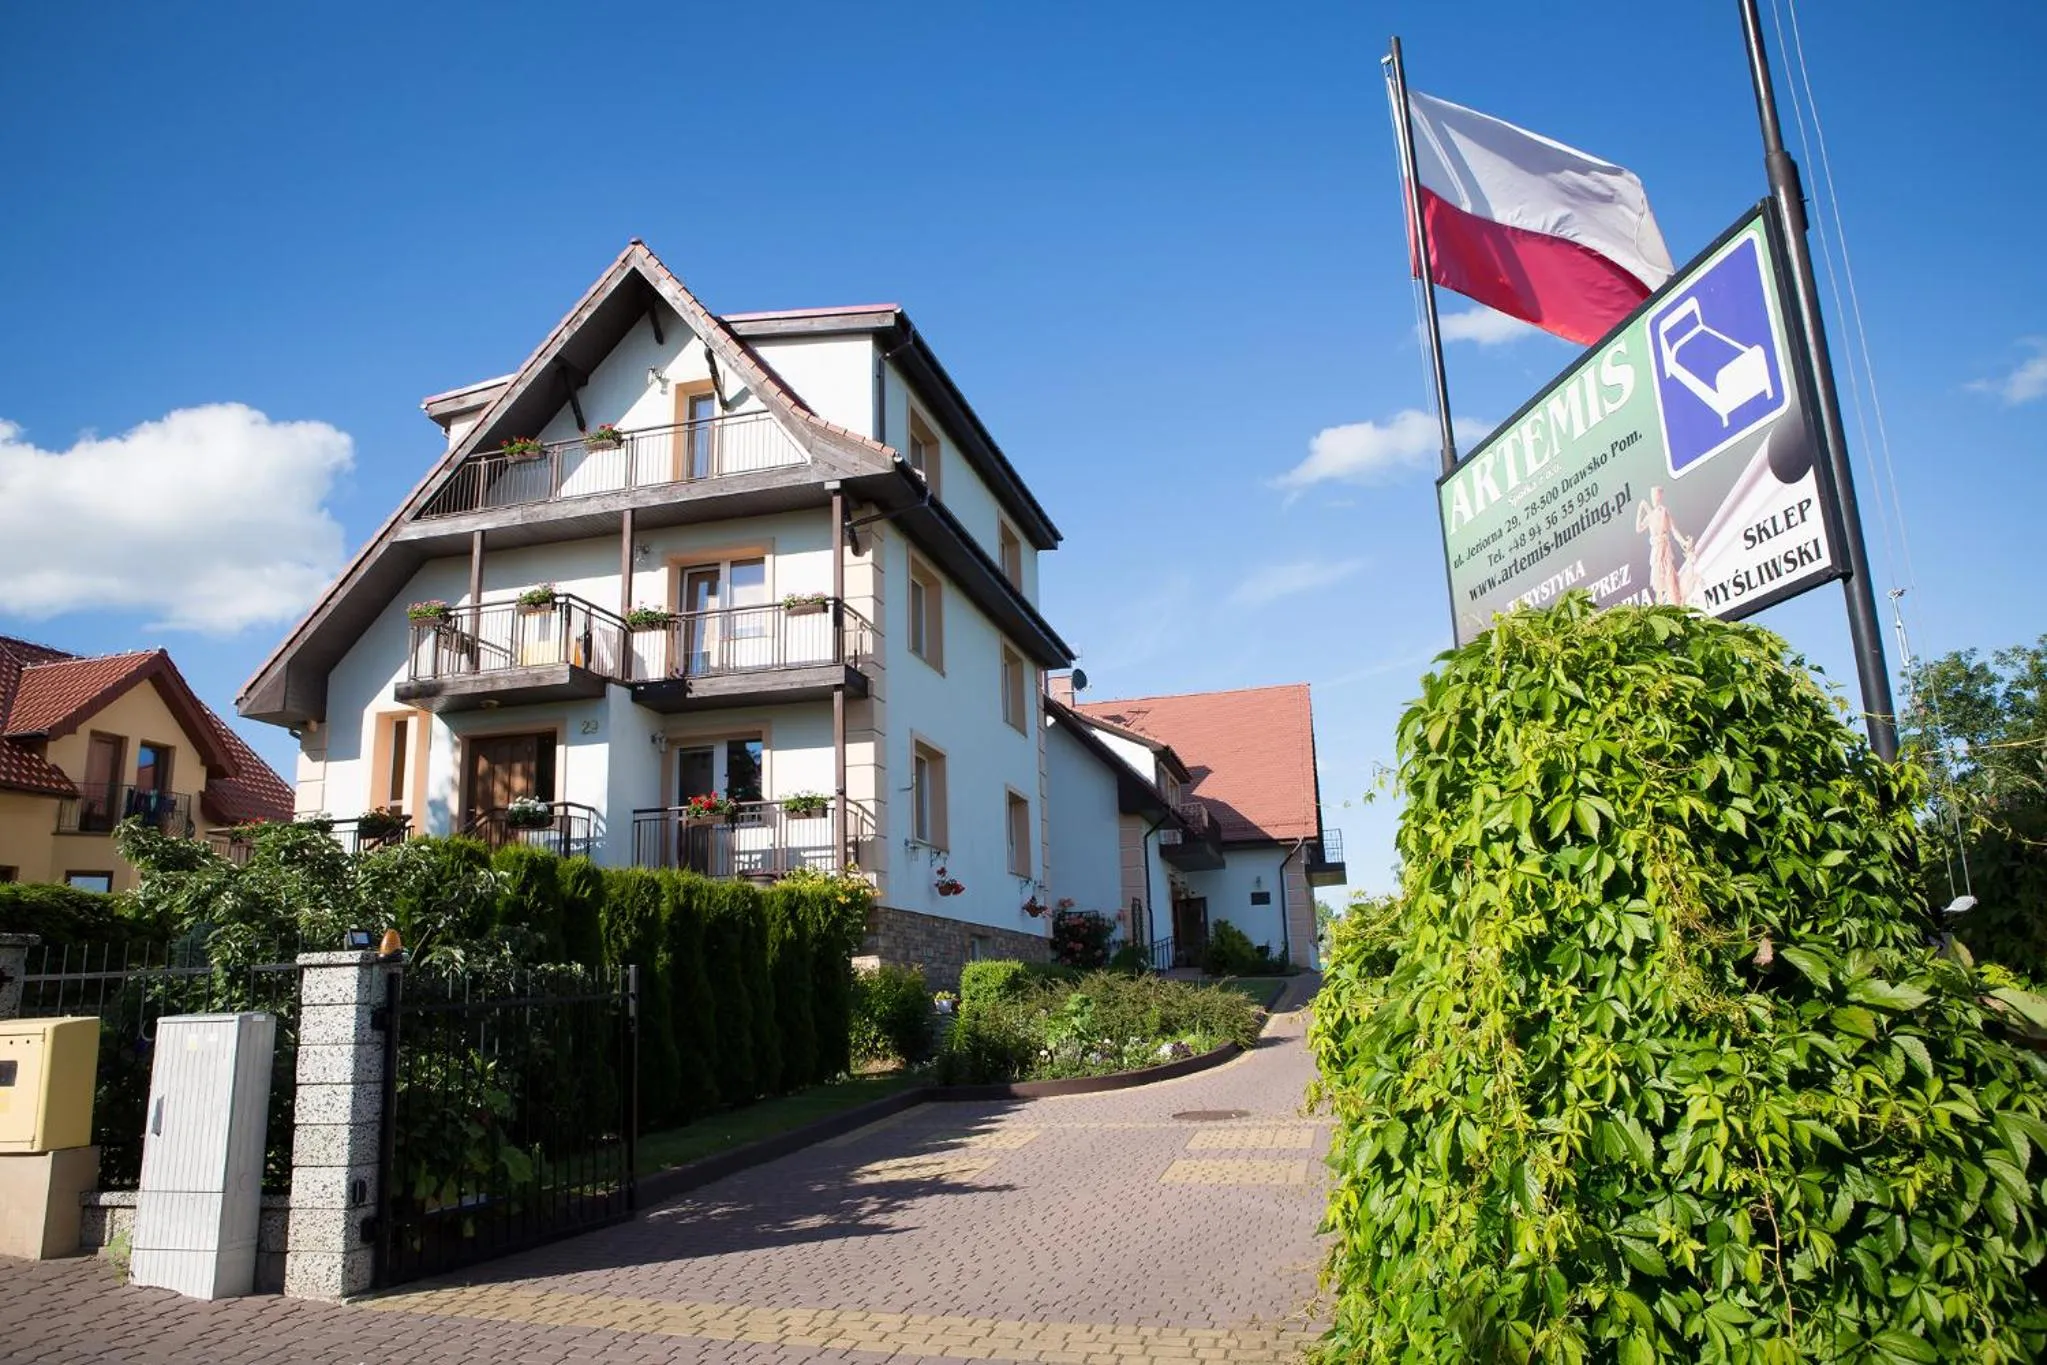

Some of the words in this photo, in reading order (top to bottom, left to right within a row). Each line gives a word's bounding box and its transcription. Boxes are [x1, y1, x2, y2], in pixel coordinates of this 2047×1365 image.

[1450, 338, 1635, 534] ARTEMIS
[1453, 554, 1464, 569] ul.
[1524, 486, 1559, 520] 78-500
[1561, 452, 1608, 493] Drawsko
[1610, 430, 1643, 458] Pom.
[1469, 482, 1632, 601] www.artemis-hunting.pl
[1488, 548, 1505, 566] Tel.
[1544, 511, 1558, 530] 36
[1577, 482, 1600, 507] 930
[1743, 498, 1812, 550] SKLEP
[1506, 560, 1586, 611] TRYSTYKA
[1704, 537, 1823, 609] MYŚLIWSKI
